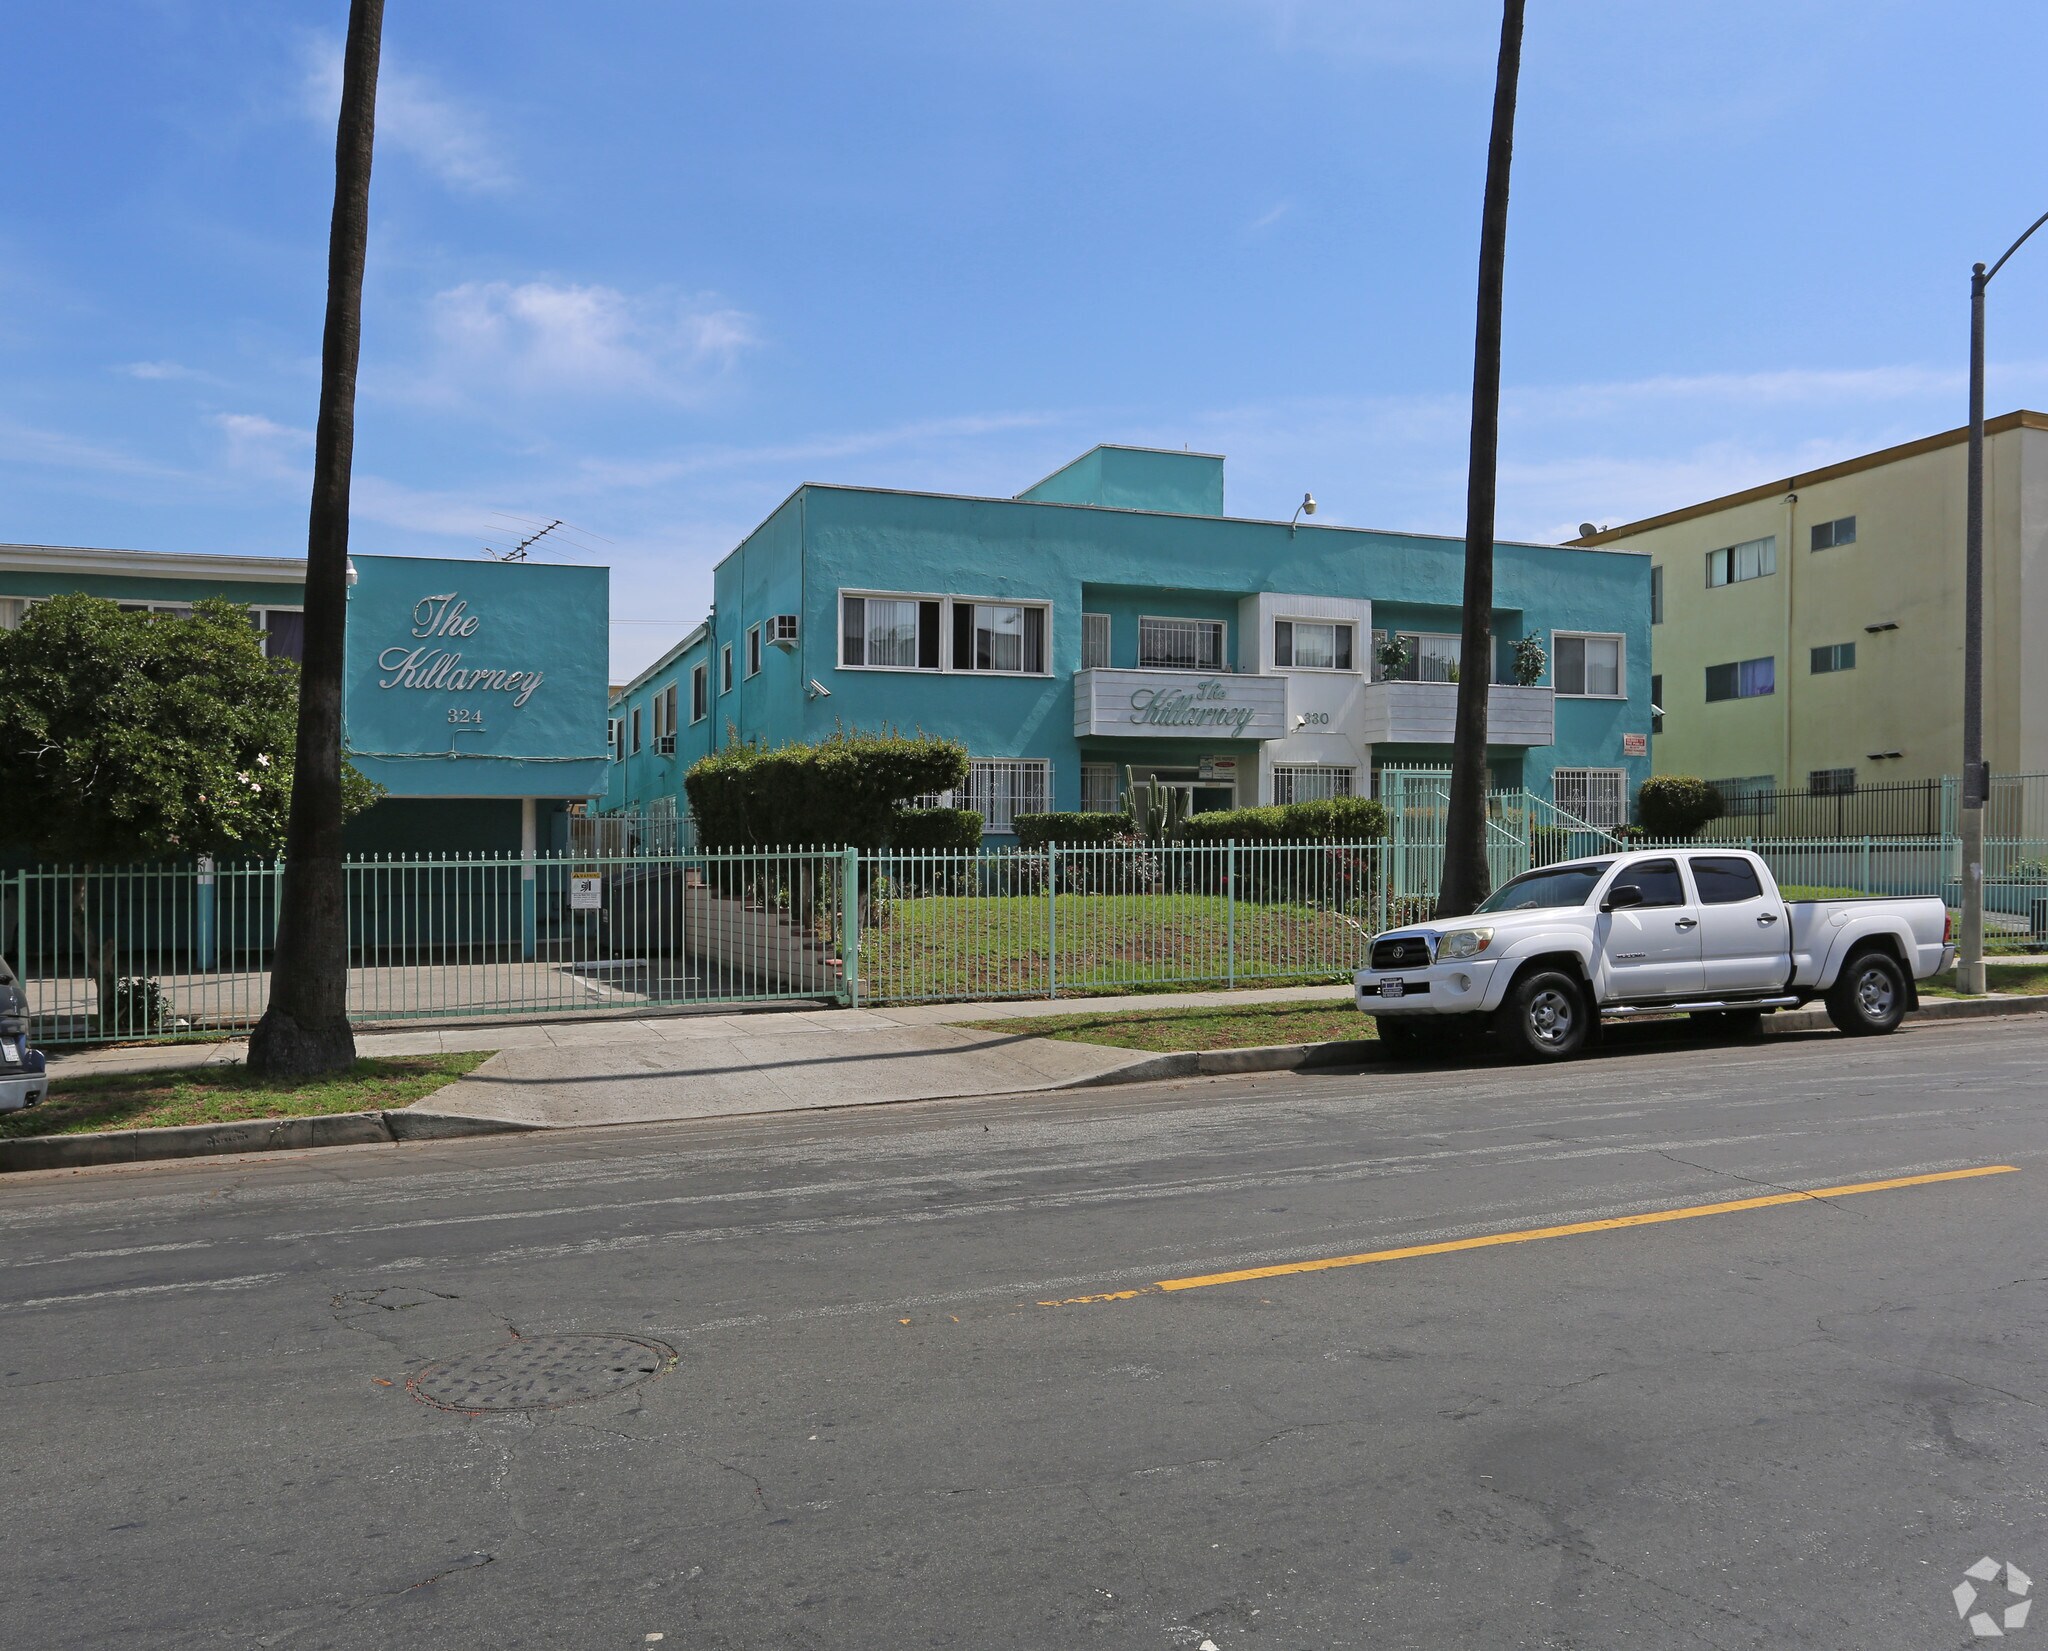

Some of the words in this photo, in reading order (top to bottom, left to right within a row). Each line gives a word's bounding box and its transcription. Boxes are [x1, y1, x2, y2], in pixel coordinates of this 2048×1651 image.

[411, 592, 480, 638] The
[378, 646, 544, 708] Killarney
[1196, 678, 1227, 701] The
[448, 708, 482, 723] 324
[1130, 688, 1255, 738] Killarney
[1304, 712, 1329, 725] 330
